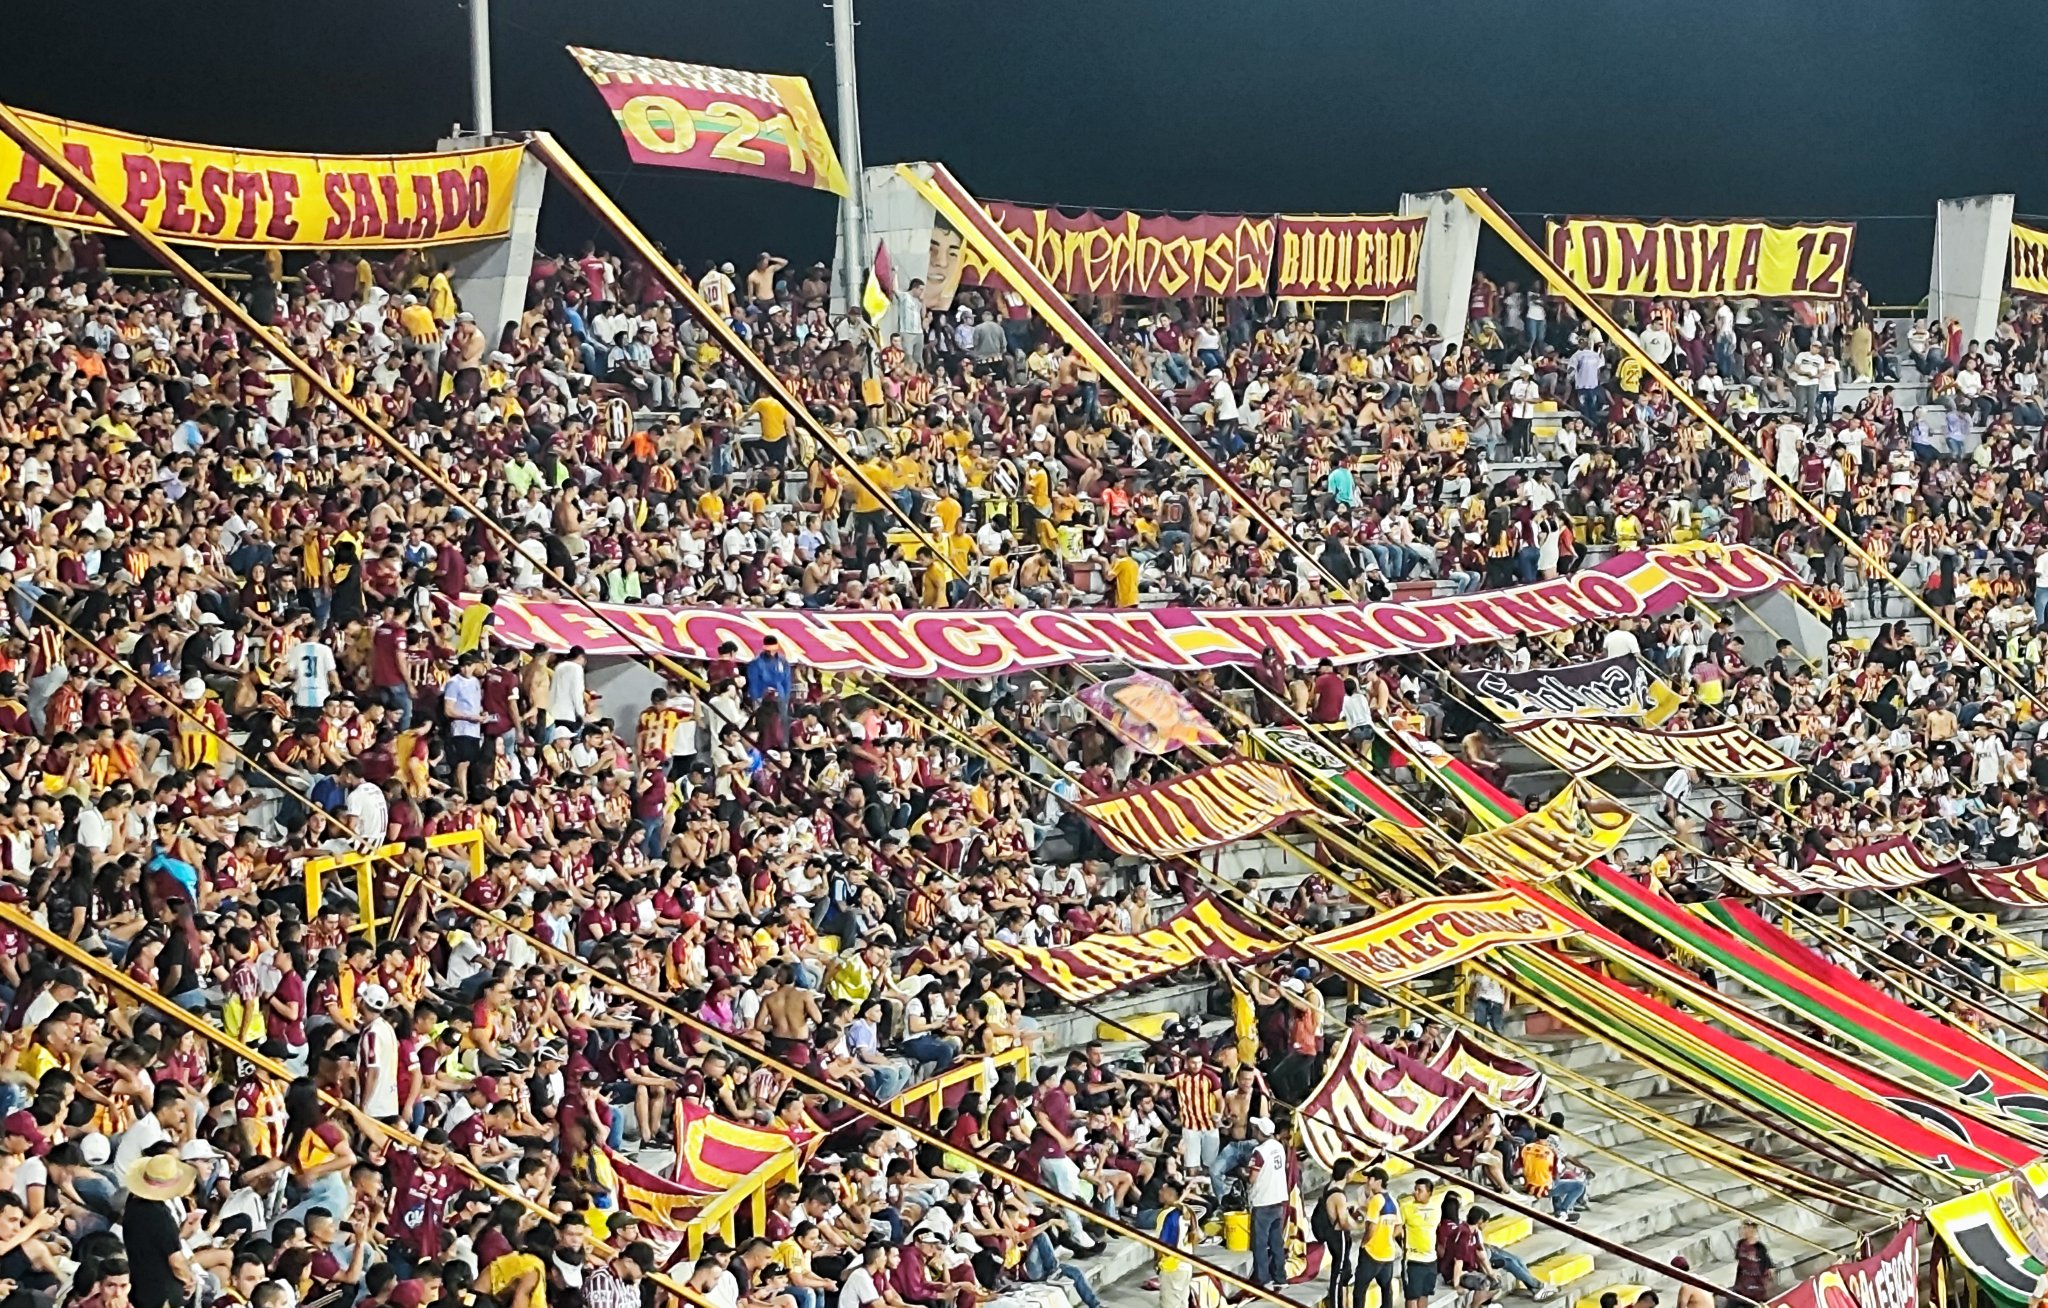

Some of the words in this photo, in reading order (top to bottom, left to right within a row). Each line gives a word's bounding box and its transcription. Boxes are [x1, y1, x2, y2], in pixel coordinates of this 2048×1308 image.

[7, 142, 98, 217] LA
[122, 153, 299, 241] PESTE
[324, 165, 488, 241] SALADO
[1279, 223, 1424, 293] BOQUERON
[1553, 227, 1763, 293] COMUNA
[1791, 232, 1849, 294] 12
[1204, 570, 1645, 665] VINOTINTO
[1654, 549, 1788, 594] SU
